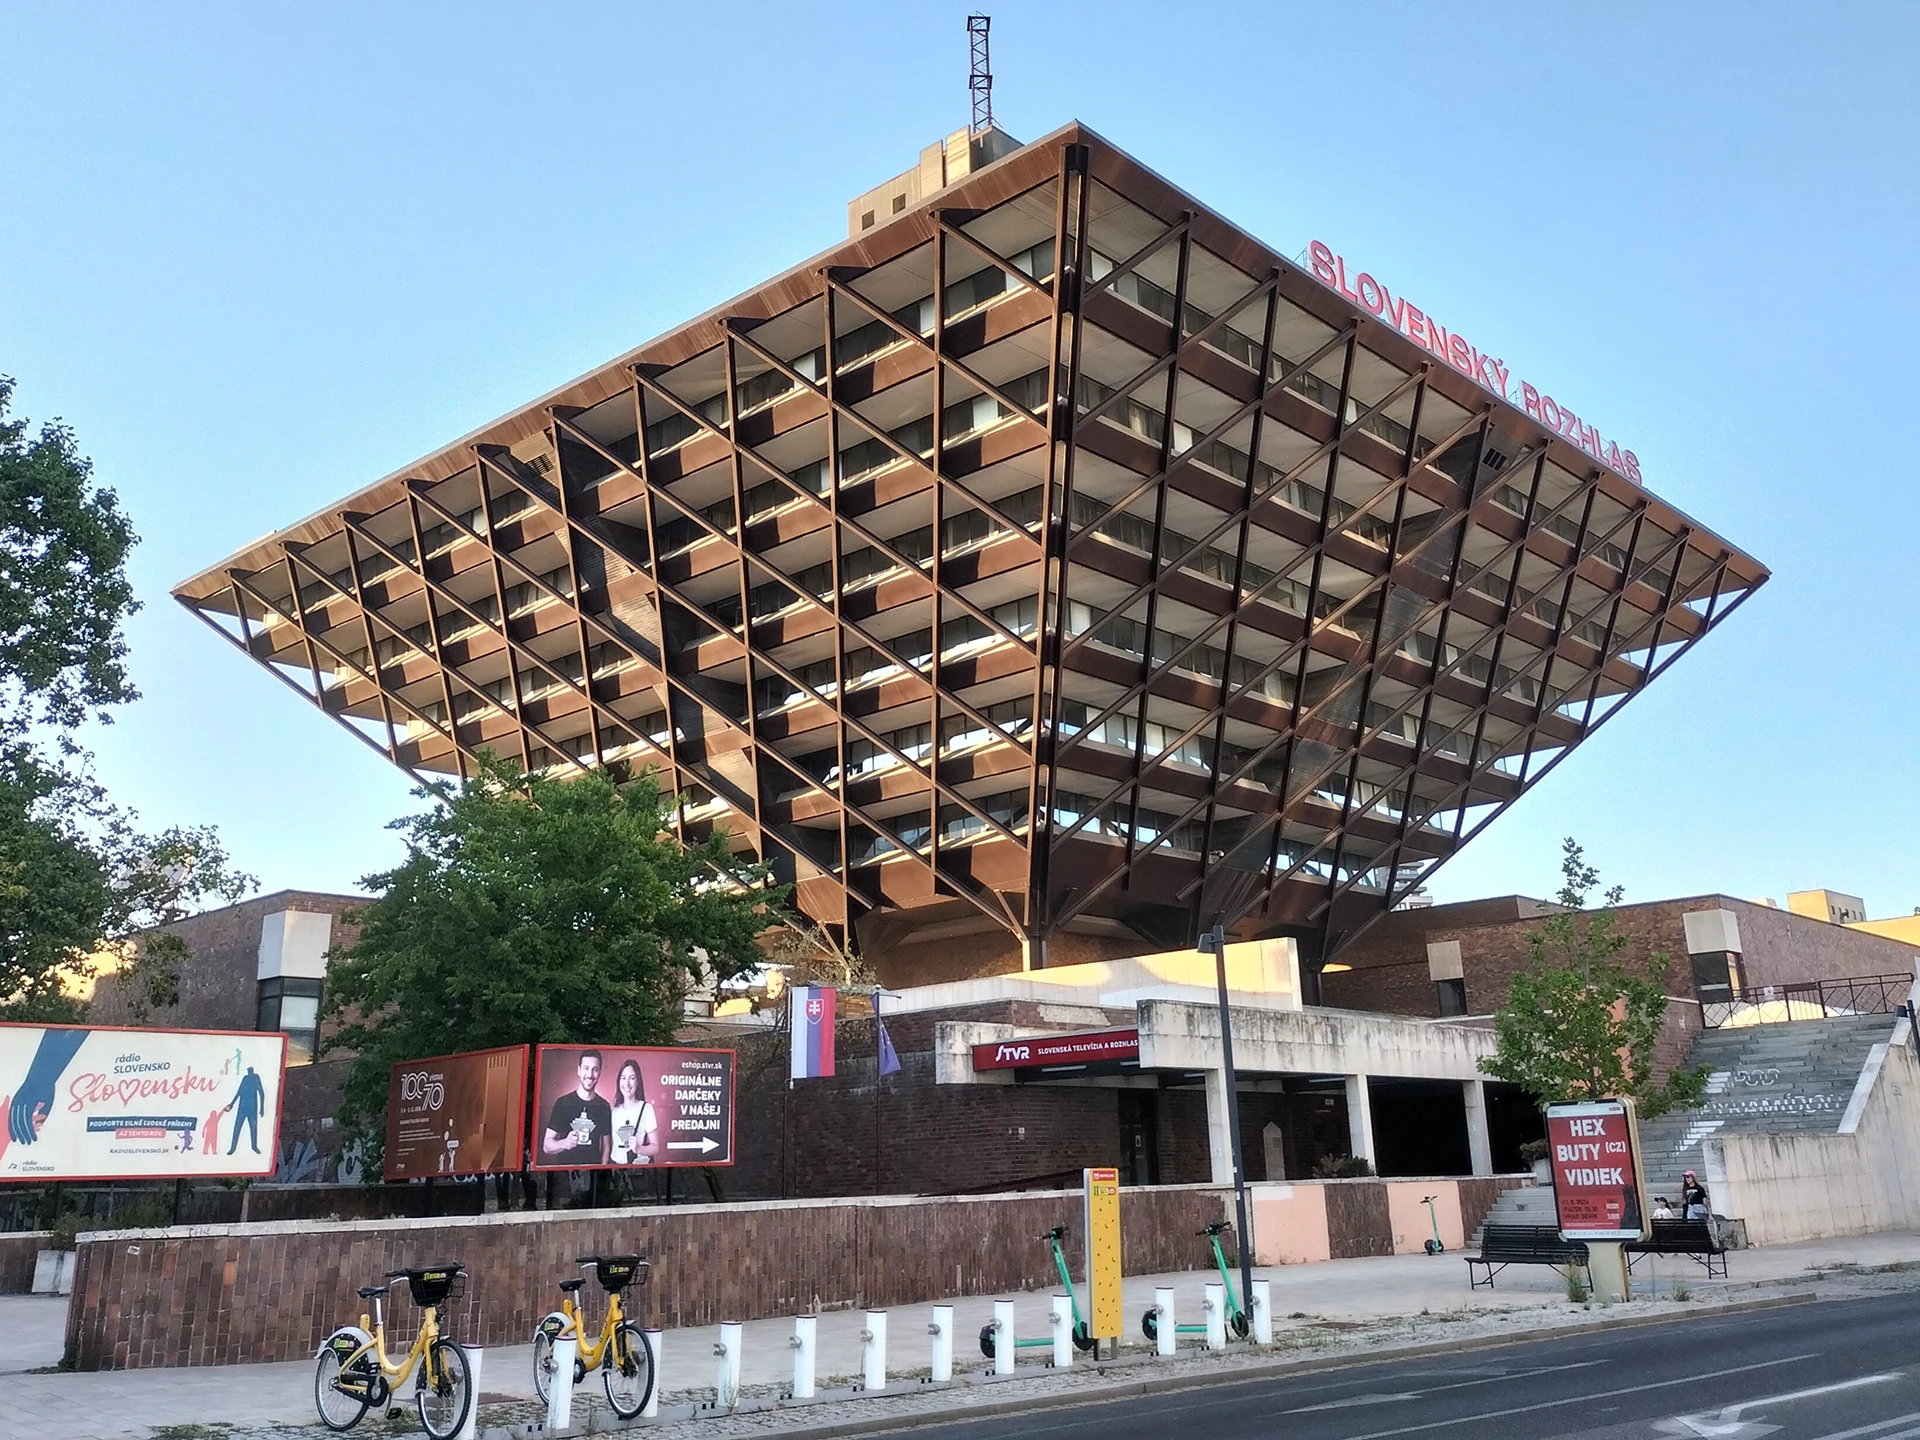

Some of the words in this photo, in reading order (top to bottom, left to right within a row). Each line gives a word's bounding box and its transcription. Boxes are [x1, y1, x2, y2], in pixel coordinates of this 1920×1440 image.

[1308, 239, 1509, 399] SLOVENSKÝ
[1520, 380, 1643, 486] ROZHLAS
[995, 1044, 1030, 1061] STVR
[1038, 1044, 1072, 1055] SLOVENSKÁ
[1073, 1042, 1103, 1053] TELEVÍZIA
[1110, 1039, 1138, 1049] ROZHLAS
[115, 1053, 141, 1064] rádio
[113, 1062, 171, 1074] SLOVENSKO
[681, 1061, 722, 1070] eshop.stvr.sk
[661, 1073, 722, 1086] ORIGINÁLNE
[422, 1082, 445, 1111] 70
[675, 1088, 721, 1101] DARČEKY
[680, 1105, 688, 1115] V
[689, 1102, 721, 1115] NAŠEJ
[124, 1118, 143, 1126] SILNÉ
[671, 1119, 720, 1130] PREDAJNI
[1570, 1119, 1606, 1137] HEX
[1556, 1143, 1600, 1162] BUTY
[1605, 1141, 1626, 1153] (CZ)
[1564, 1167, 1625, 1186] VIDIEK
